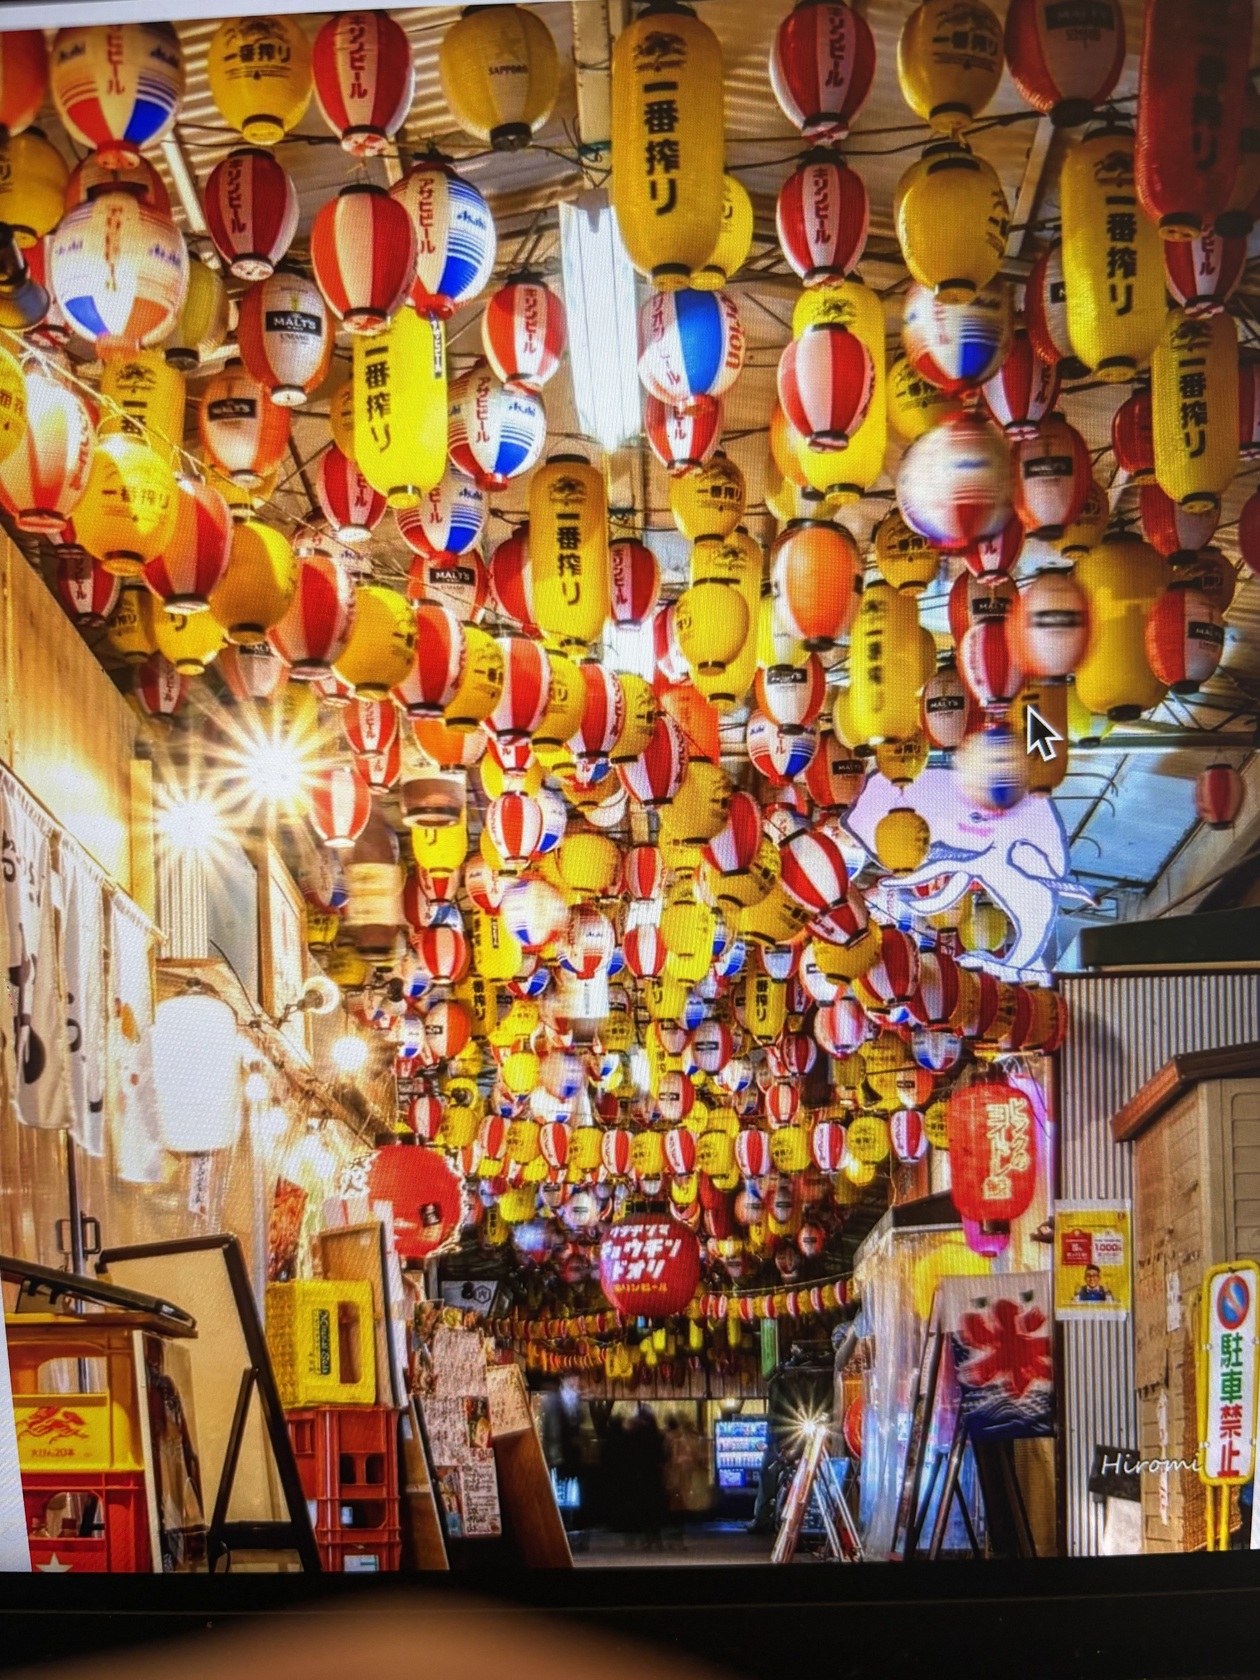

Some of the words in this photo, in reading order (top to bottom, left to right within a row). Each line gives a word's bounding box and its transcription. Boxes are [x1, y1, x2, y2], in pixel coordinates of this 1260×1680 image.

[223, 42, 291, 63] 一番搾り
[348, 15, 368, 99] キリンビール
[488, 64, 528, 76] SAPPORO
[825, 6, 844, 88] キリンビール
[643, 81, 680, 216] 一番搾り
[226, 159, 246, 233] キリンビール
[418, 178, 436, 254] アサヒビール
[812, 166, 831, 245] キリンビール
[1105, 196, 1138, 316] 一番搾り
[273, 317, 316, 331] MALT'S
[523, 288, 538, 354] キリンビール
[365, 346, 392, 453] 一番搾り
[476, 376, 490, 443] アサヒビール
[1179, 357, 1208, 459] 一番搾り
[435, 570, 471, 582] MALT'S
[556, 513, 582, 606] 一番搾り
[613, 549, 628, 605] キリンビール
[930, 701, 959, 710] MALT'S
[612, 1258, 666, 1281] ドオリ
[1216, 1333, 1244, 1478] 駐車禁止
